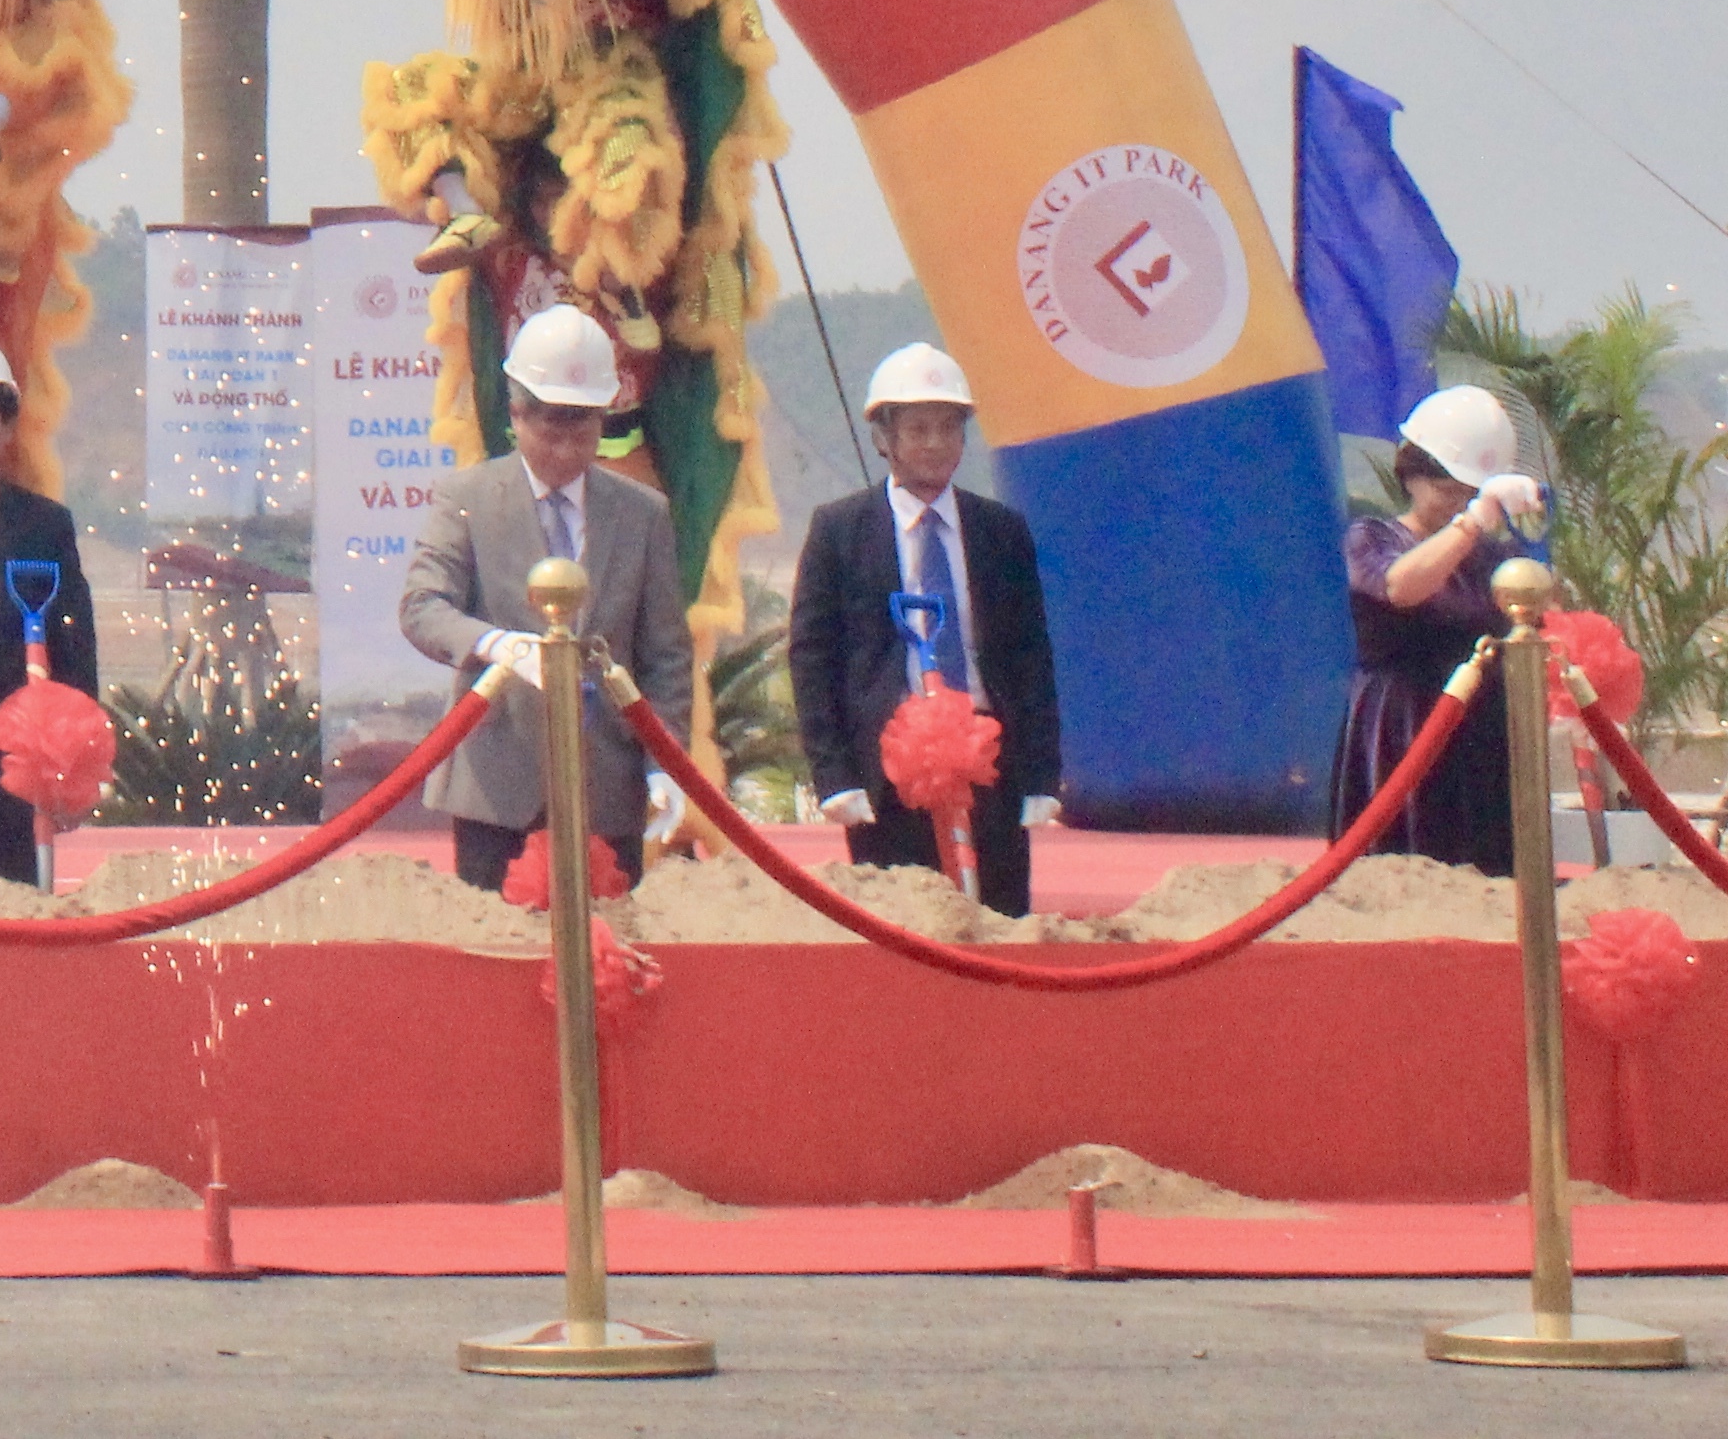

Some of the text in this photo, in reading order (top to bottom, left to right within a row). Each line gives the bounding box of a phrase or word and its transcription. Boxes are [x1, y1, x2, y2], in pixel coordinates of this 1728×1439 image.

[1023, 149, 1208, 343] DANANG IT PARK
[372, 350, 443, 378] KHÁN
[173, 388, 194, 405] VÀ
[349, 418, 433, 437] DANA
[376, 448, 432, 467] GIAI
[360, 480, 397, 509] VÀ
